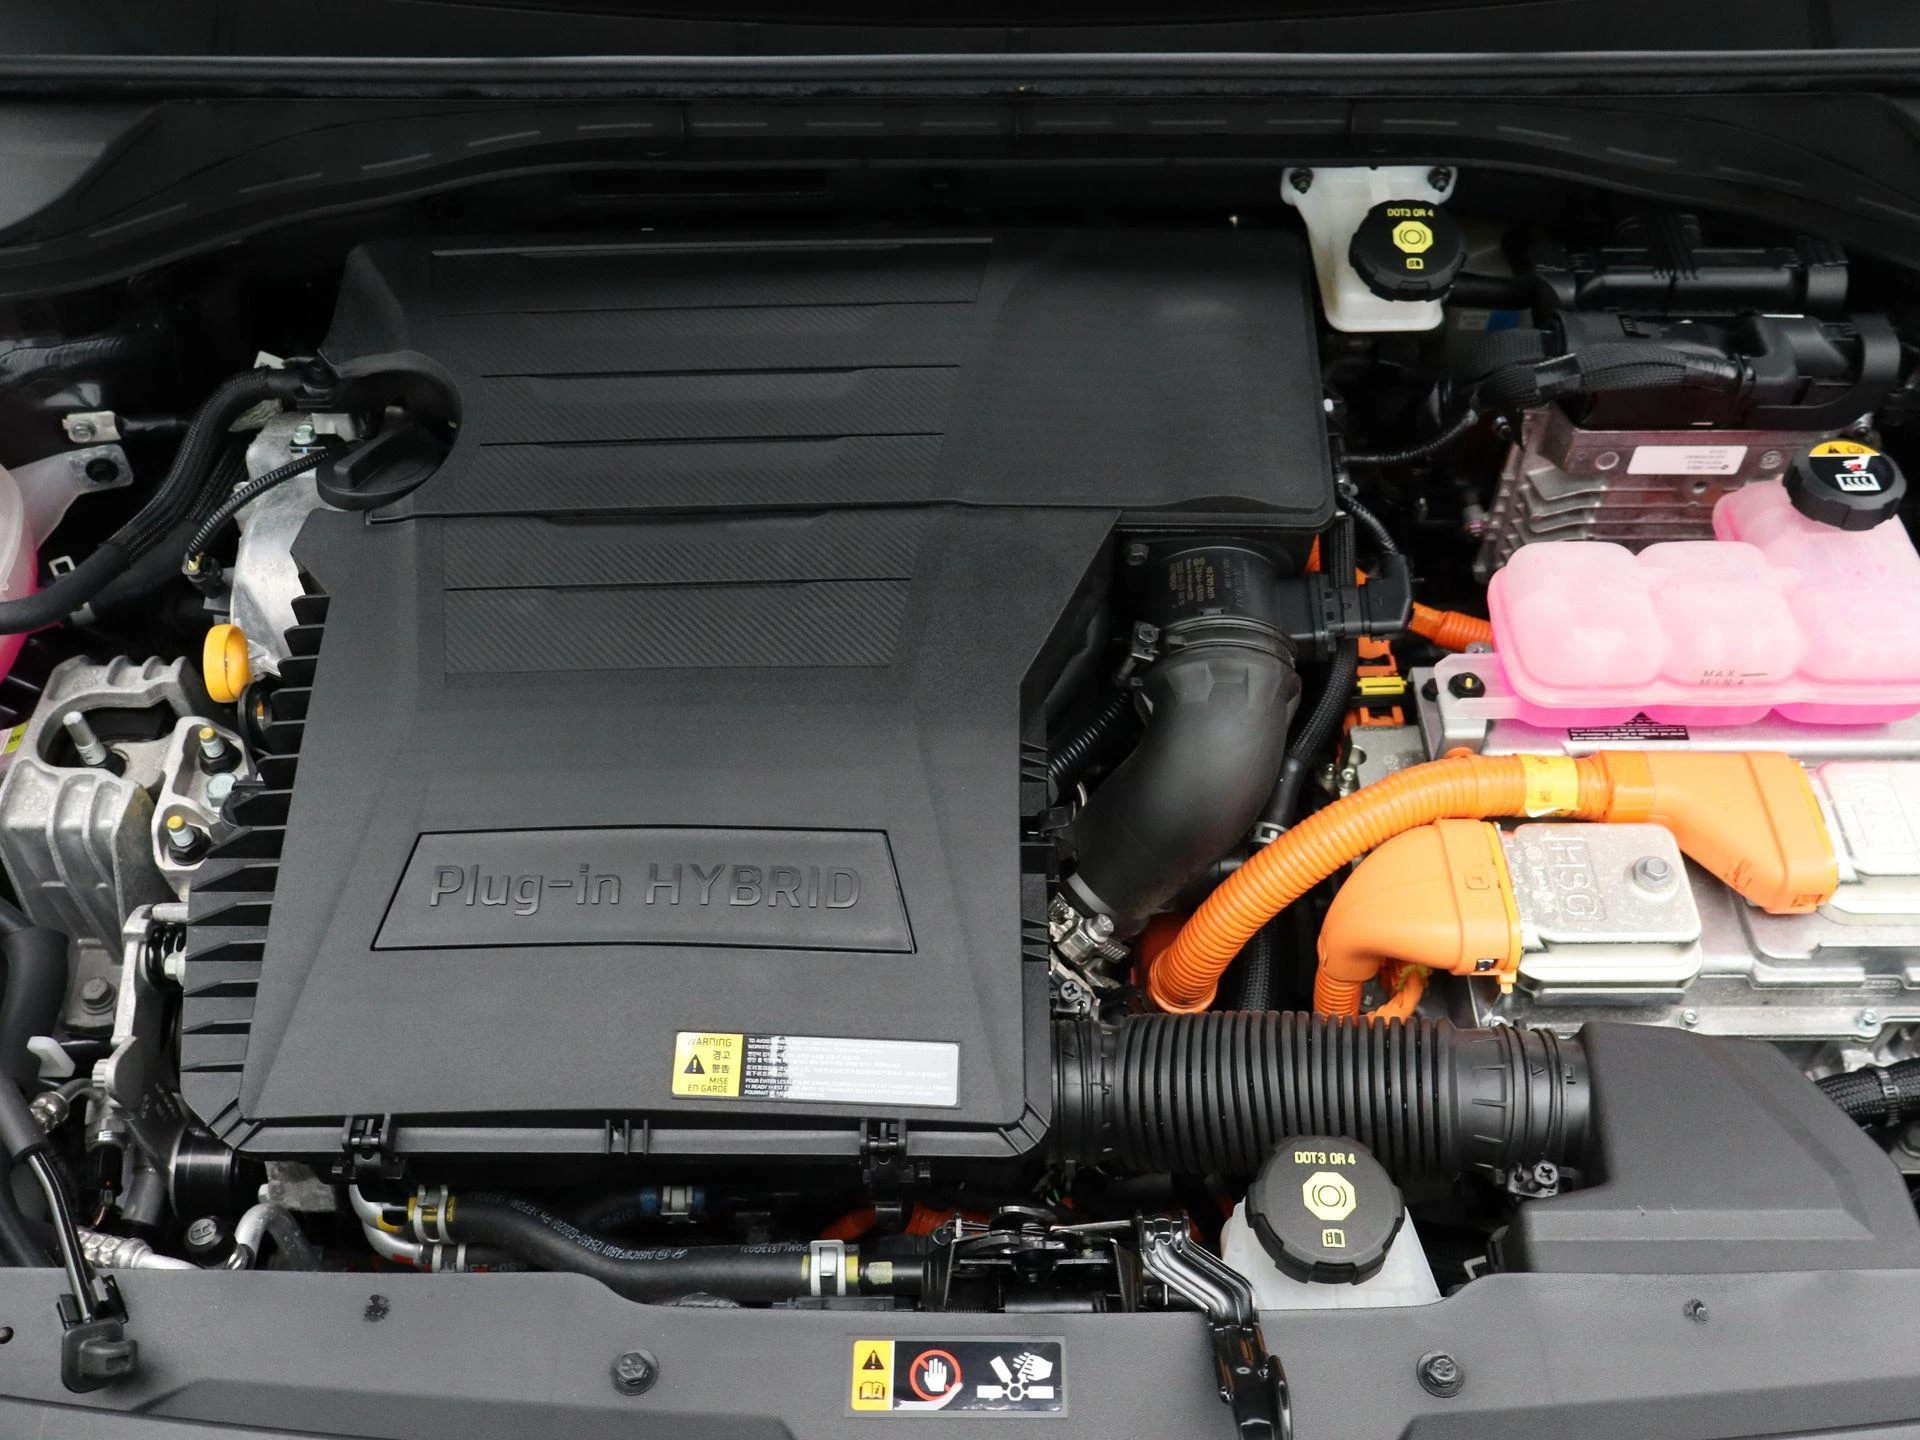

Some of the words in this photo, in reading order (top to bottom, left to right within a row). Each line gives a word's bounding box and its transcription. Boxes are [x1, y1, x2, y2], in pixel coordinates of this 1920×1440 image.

[1387, 208, 1411, 217] DOT3
[1413, 209, 1426, 217] OR
[1427, 209, 1434, 217] 4
[1702, 669, 1736, 678] MAX
[428, 863, 623, 917] Plug-in
[645, 862, 862, 910] HYBRID
[688, 1037, 732, 1047] WARNING
[713, 1050, 731, 1061] 경고
[712, 1064, 731, 1074] 警告
[709, 1077, 729, 1085] MISE
[688, 1084, 698, 1092] EN
[701, 1085, 728, 1093] GARDE
[1294, 1151, 1327, 1165] DOT3
[1330, 1152, 1346, 1165] OR
[1348, 1153, 1356, 1165] 4
